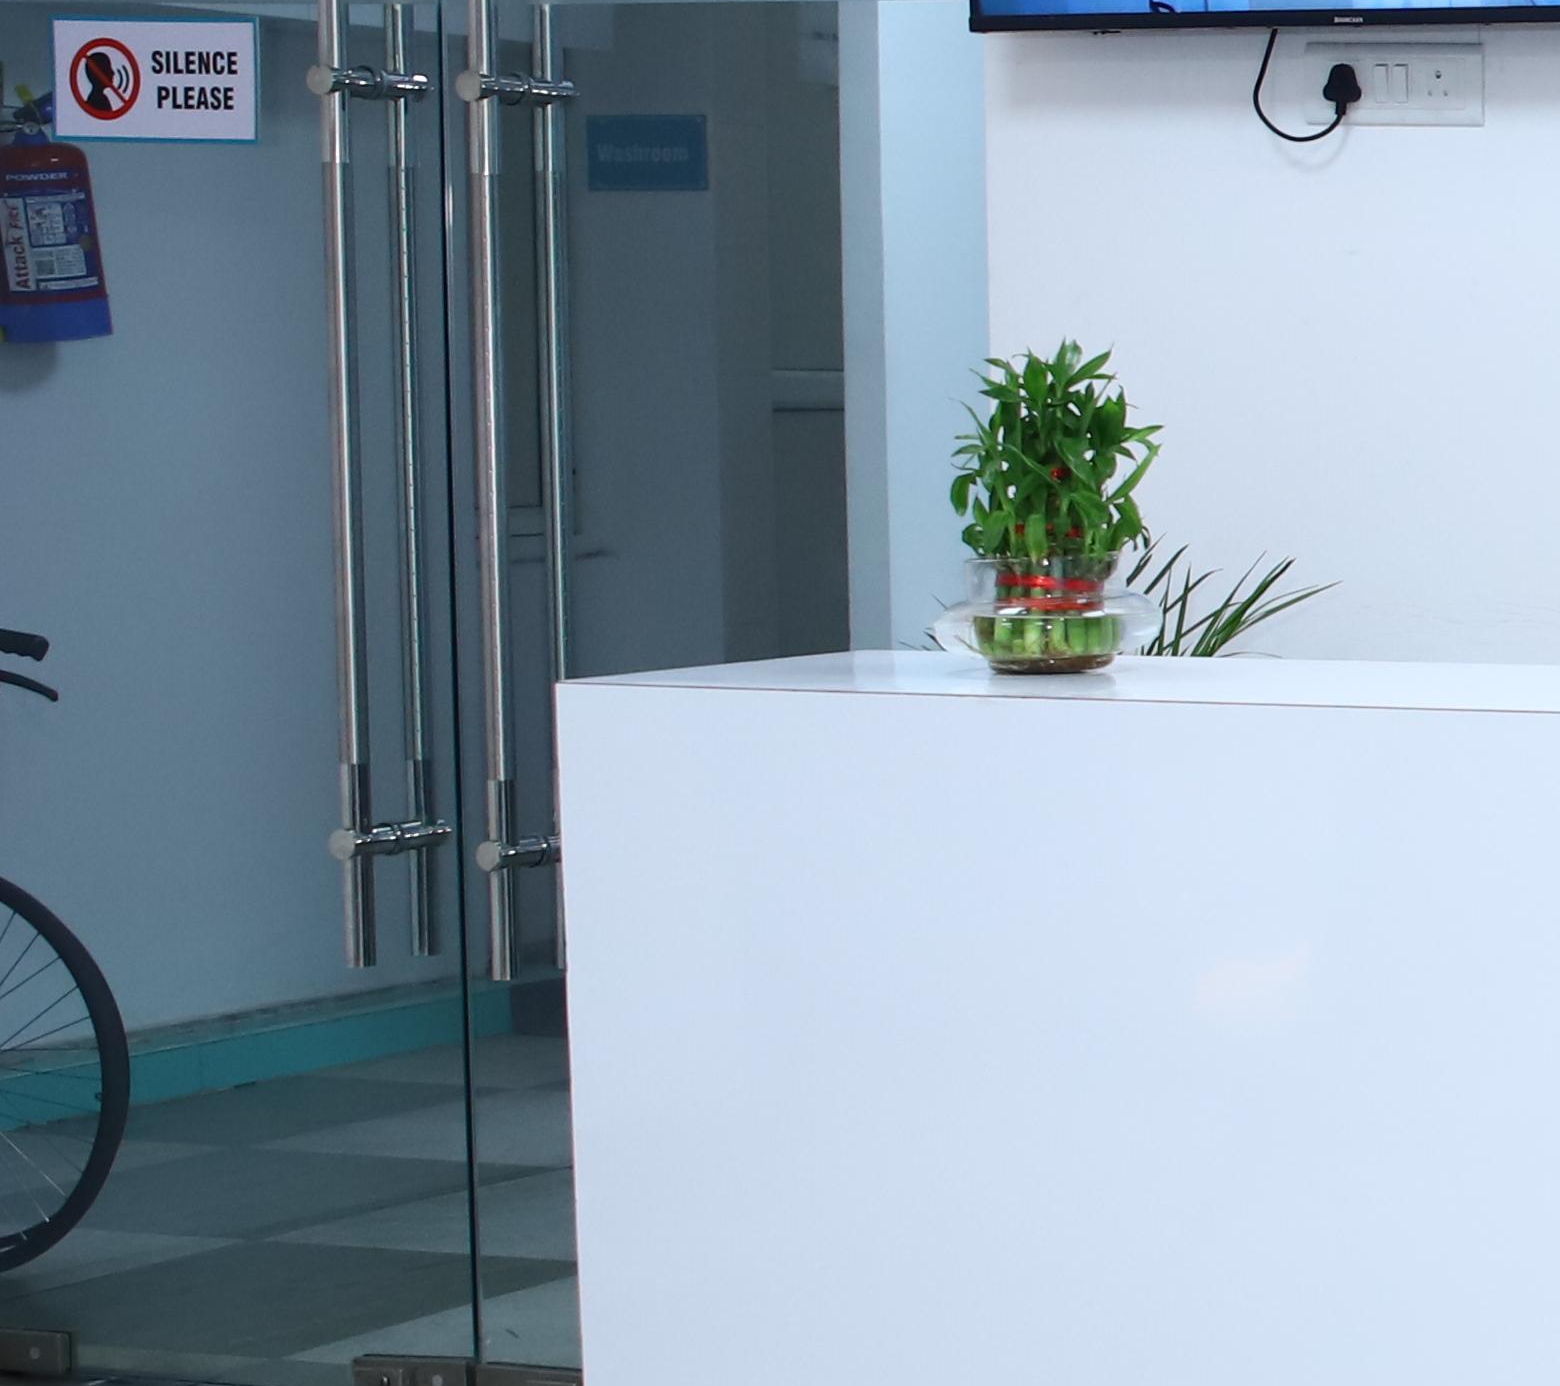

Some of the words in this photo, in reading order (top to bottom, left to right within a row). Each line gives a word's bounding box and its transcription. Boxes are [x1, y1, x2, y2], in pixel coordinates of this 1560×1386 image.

[151, 50, 239, 76] SILENCE
[156, 85, 235, 111] PLEASE
[5, 171, 69, 182] POWDER
[9, 234, 32, 290] Attack
